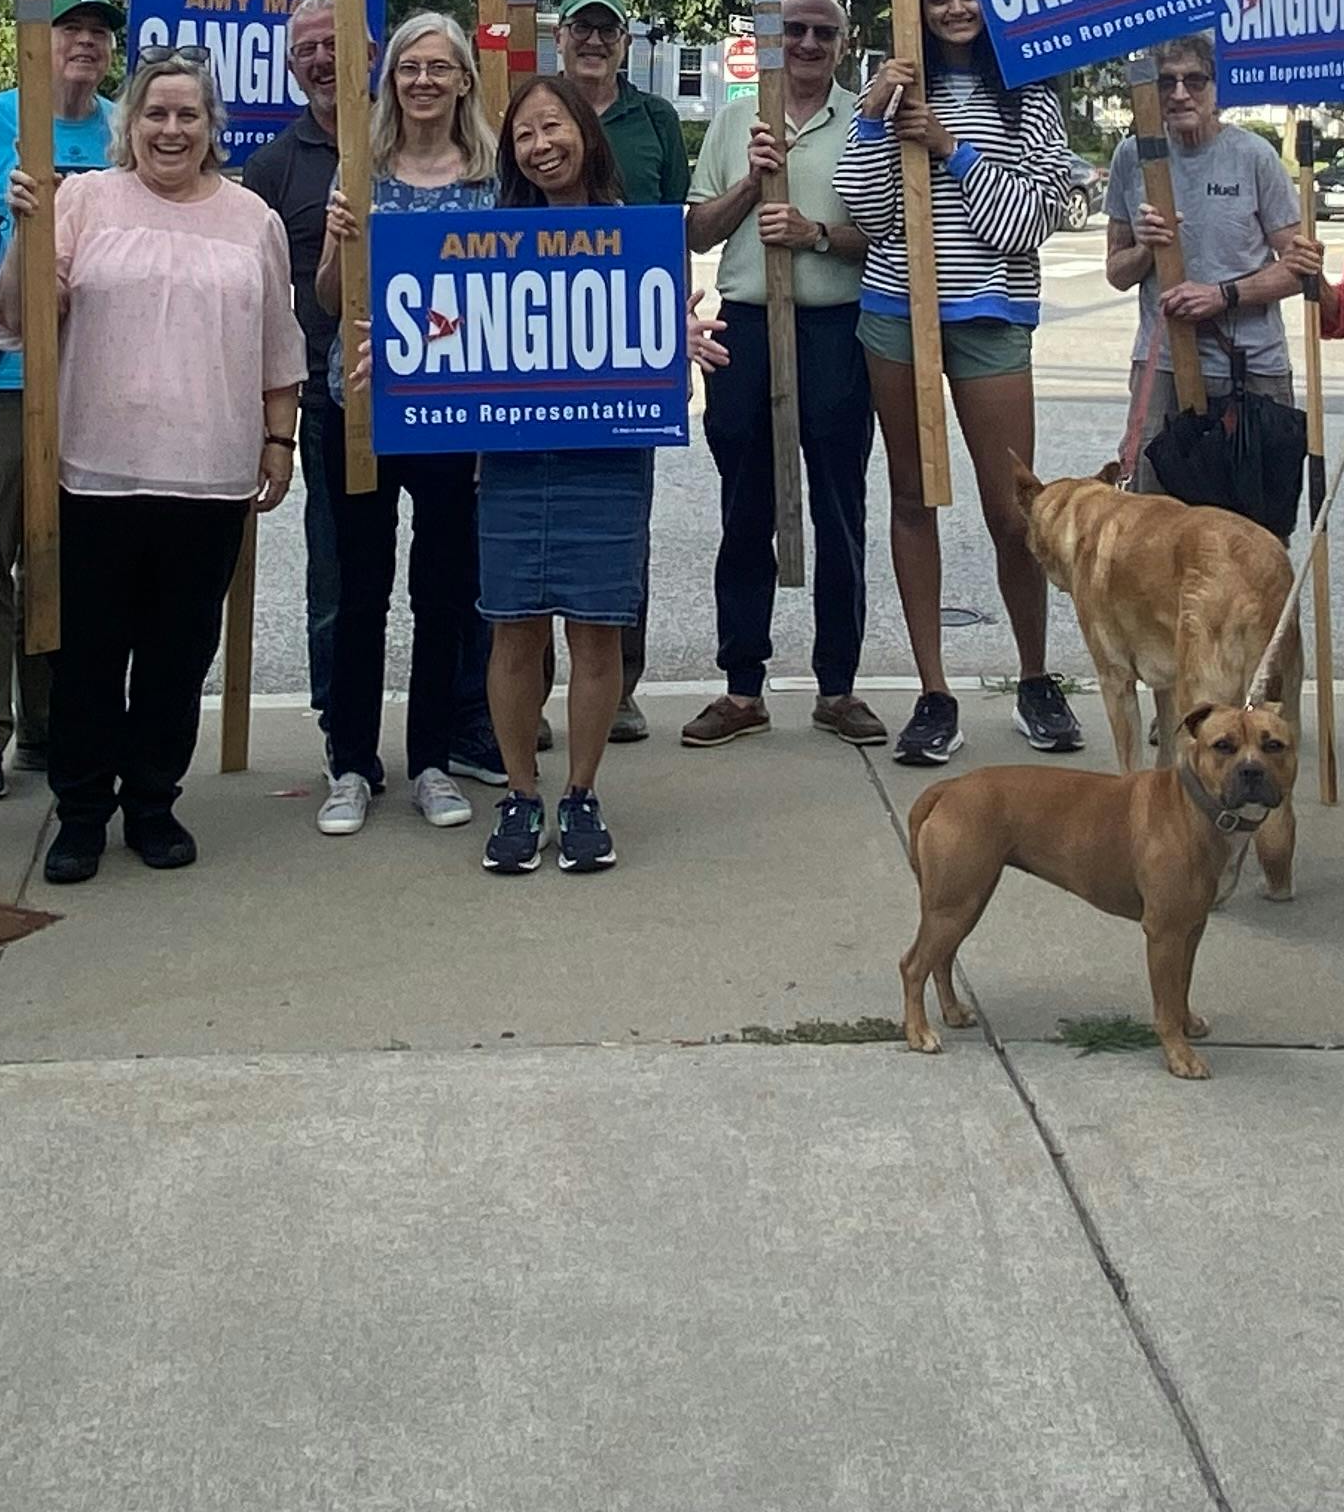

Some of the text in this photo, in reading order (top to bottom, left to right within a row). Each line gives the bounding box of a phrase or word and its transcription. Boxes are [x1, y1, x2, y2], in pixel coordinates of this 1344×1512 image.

[1021, 34, 1072, 59] State
[1231, 66, 1264, 84] State
[440, 229, 622, 260] AMY MAH
[385, 267, 676, 376] SANGIOLO
[405, 400, 661, 425] State Representative
